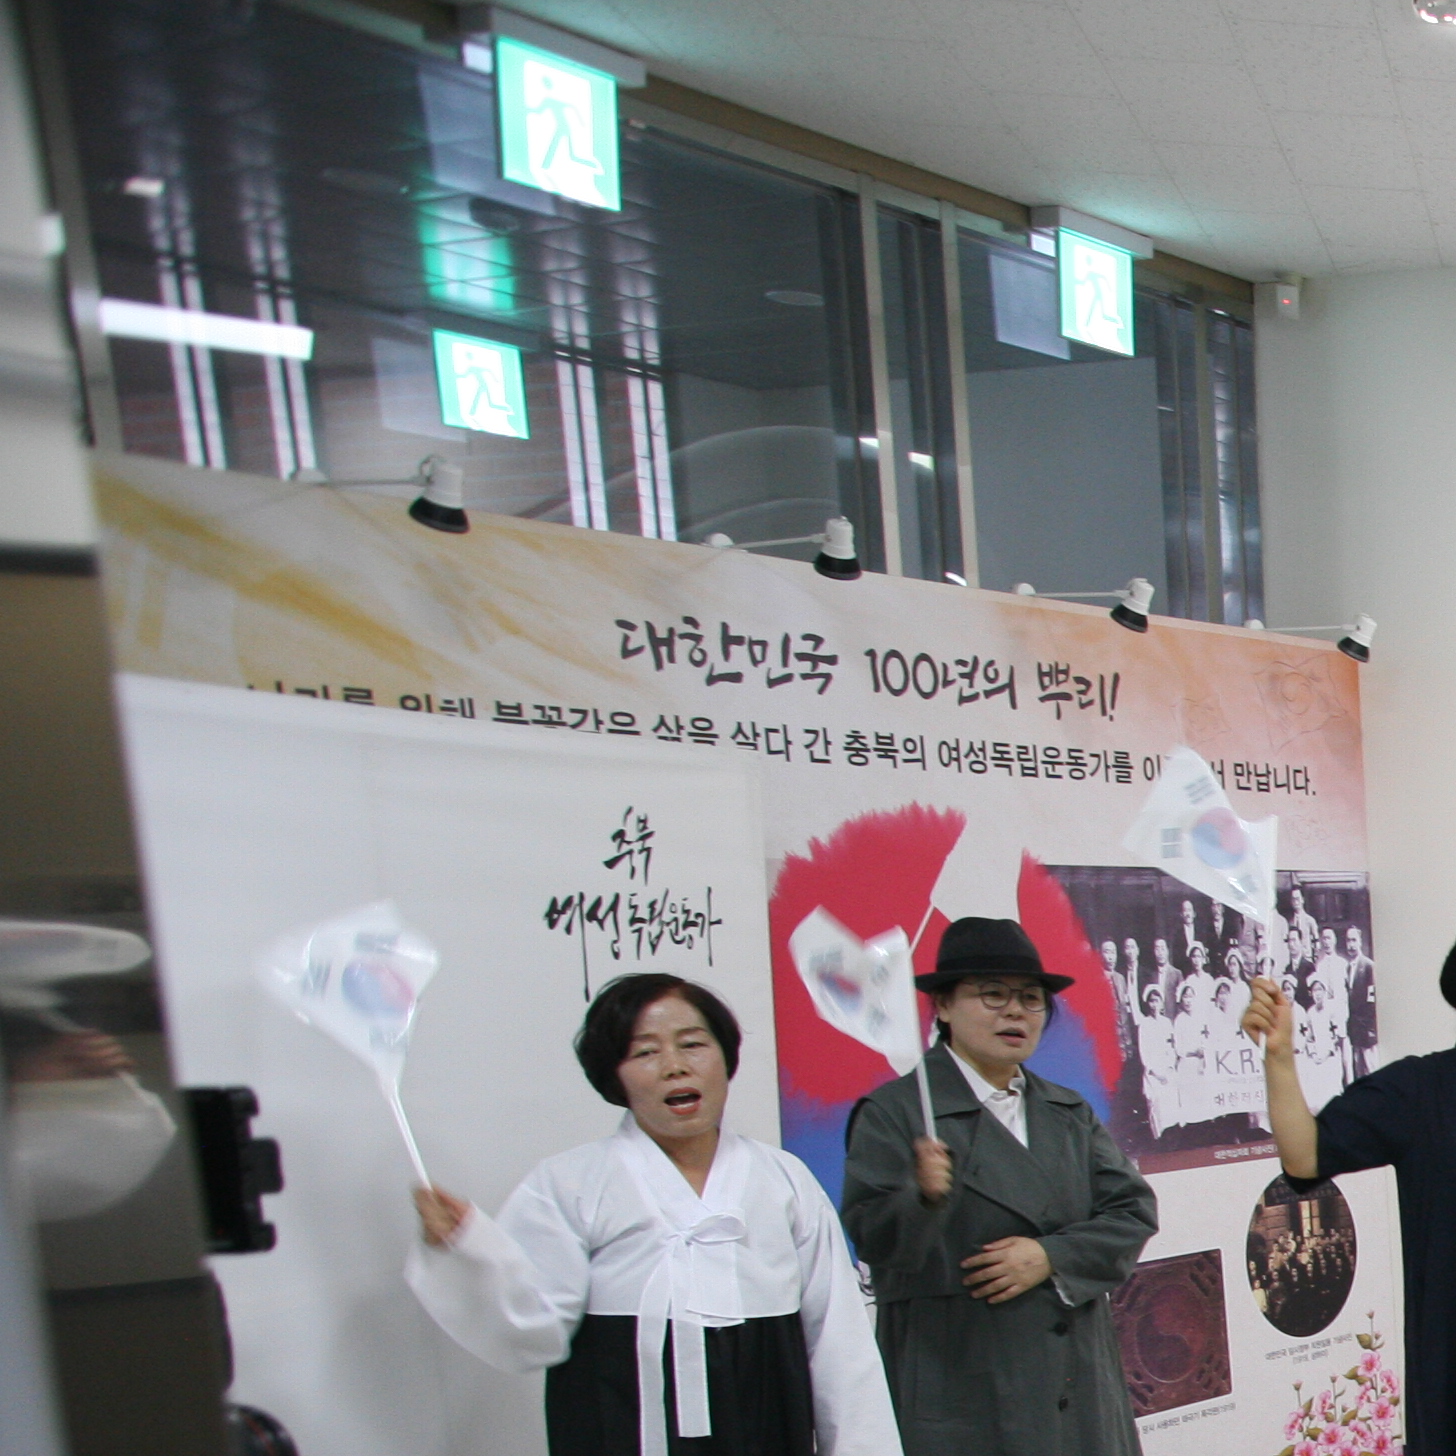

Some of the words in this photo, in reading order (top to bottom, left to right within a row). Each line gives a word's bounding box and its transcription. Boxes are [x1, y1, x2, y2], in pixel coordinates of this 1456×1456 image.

[615, 615, 839, 695] 대한민국
[864, 648, 1018, 710] 100년의
[1037, 661, 1120, 722] 뿌리!
[803, 726, 832, 764] 간
[843, 729, 927, 771] 충북의
[939, 737, 1134, 784] 여성독립운동가를
[1143, 754, 1226, 790] 이서
[1233, 760, 1317, 796] 만납니다.
